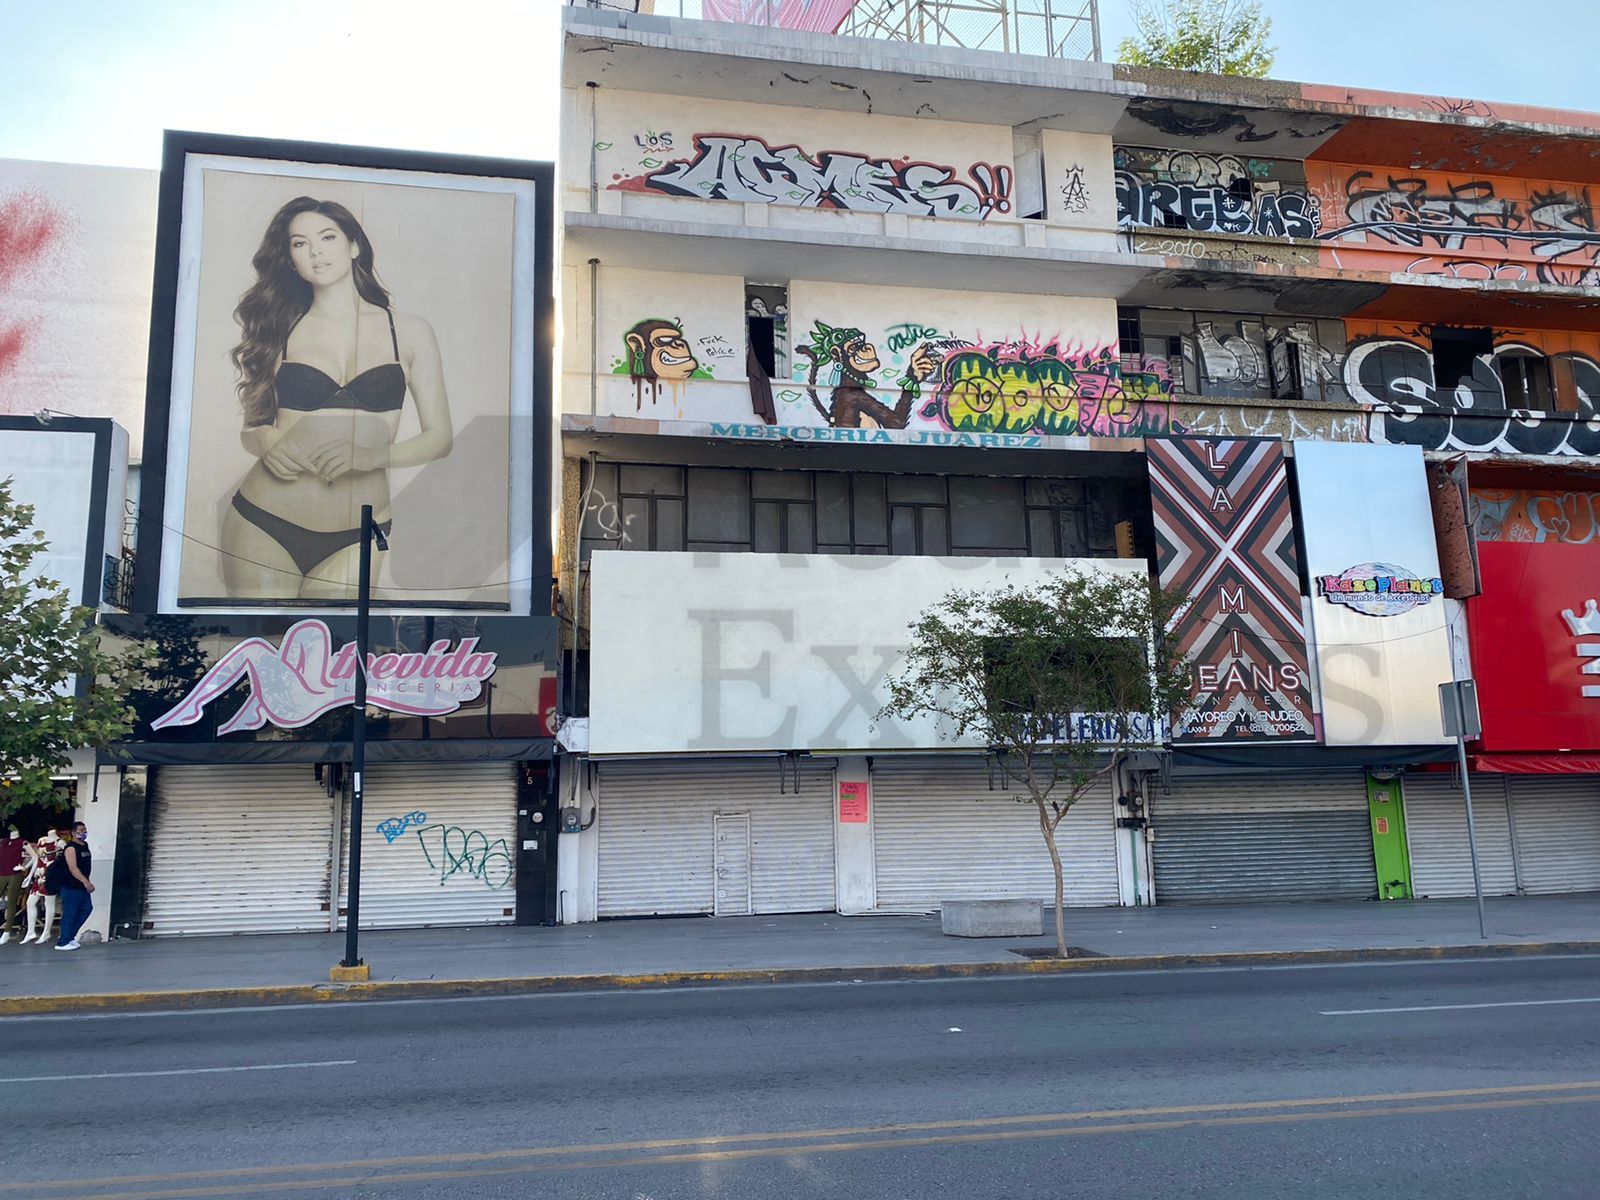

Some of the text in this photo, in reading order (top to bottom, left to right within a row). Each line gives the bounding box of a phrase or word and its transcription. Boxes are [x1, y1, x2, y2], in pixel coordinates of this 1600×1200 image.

[634, 131, 673, 147] LOS
[709, 422, 1042, 448] MERCERIA JUAREZ
[1344, 593, 1375, 602] mundo
[1376, 593, 1388, 602] de
[345, 682, 474, 693] LNCERIA
[1180, 710, 1304, 724] MAYOREO Y MENUDEO
